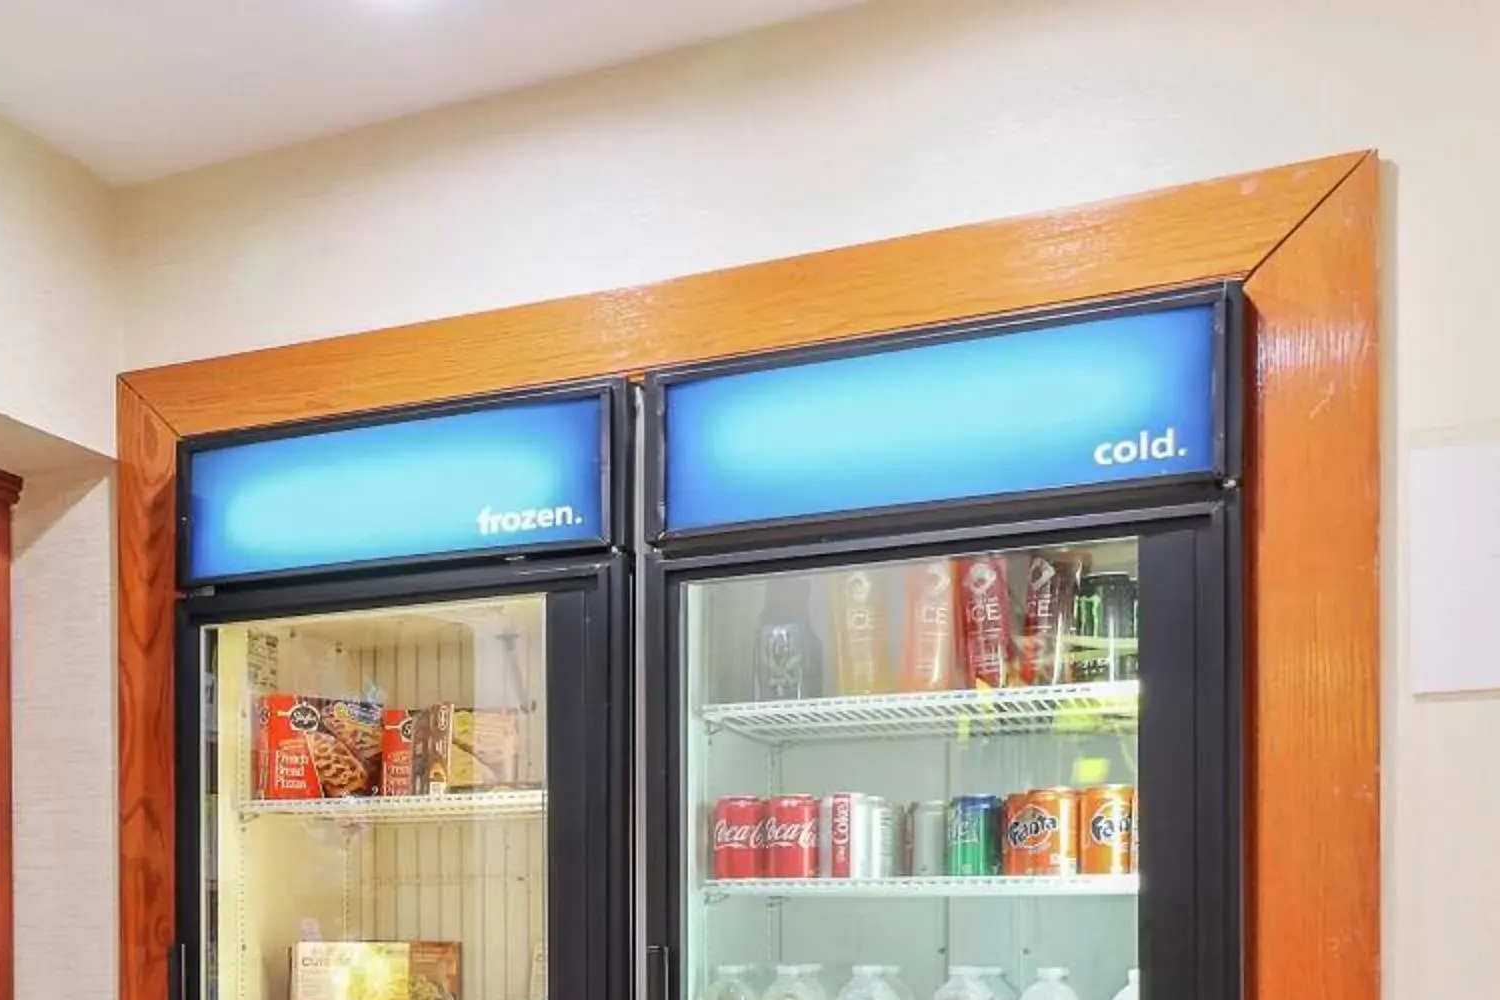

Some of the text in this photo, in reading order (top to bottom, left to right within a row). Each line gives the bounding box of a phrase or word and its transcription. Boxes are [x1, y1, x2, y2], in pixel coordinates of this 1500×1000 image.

[1094, 428, 1187, 465] cold.
[478, 506, 583, 536] frozen.
[1009, 815, 1057, 846] Fanta
